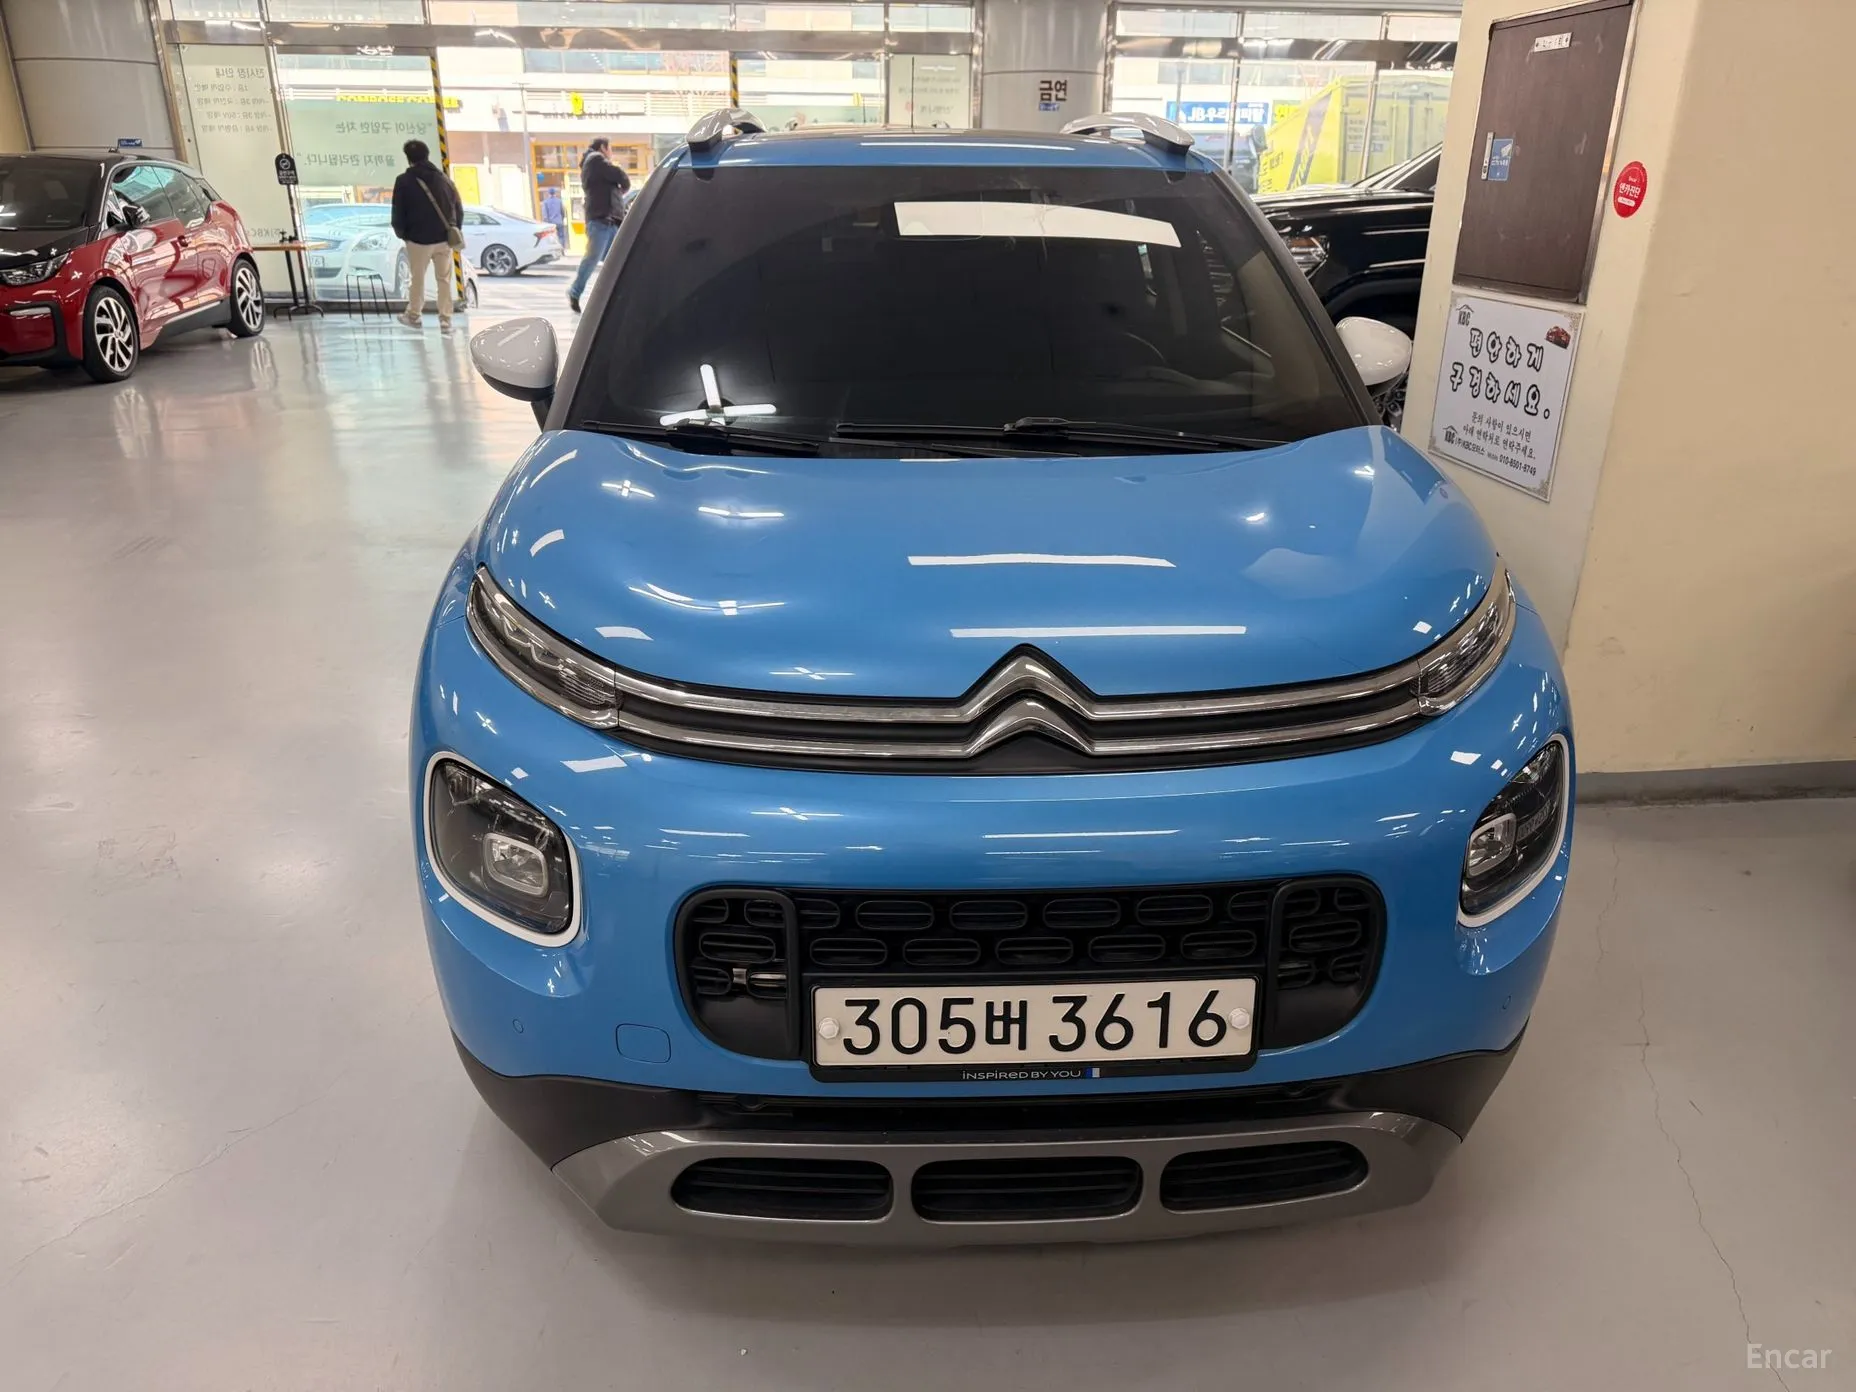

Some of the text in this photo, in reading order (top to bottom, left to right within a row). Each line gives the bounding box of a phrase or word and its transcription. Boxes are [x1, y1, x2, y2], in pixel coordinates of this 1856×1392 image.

[1039, 80, 1067, 102] 금연
[1457, 310, 1471, 327] KBC
[1506, 423, 1532, 443] 있으시면
[842, 989, 1229, 1056] 305버 3616
[1030, 1070, 1048, 1079] BY
[1050, 1069, 1081, 1079] YOU
